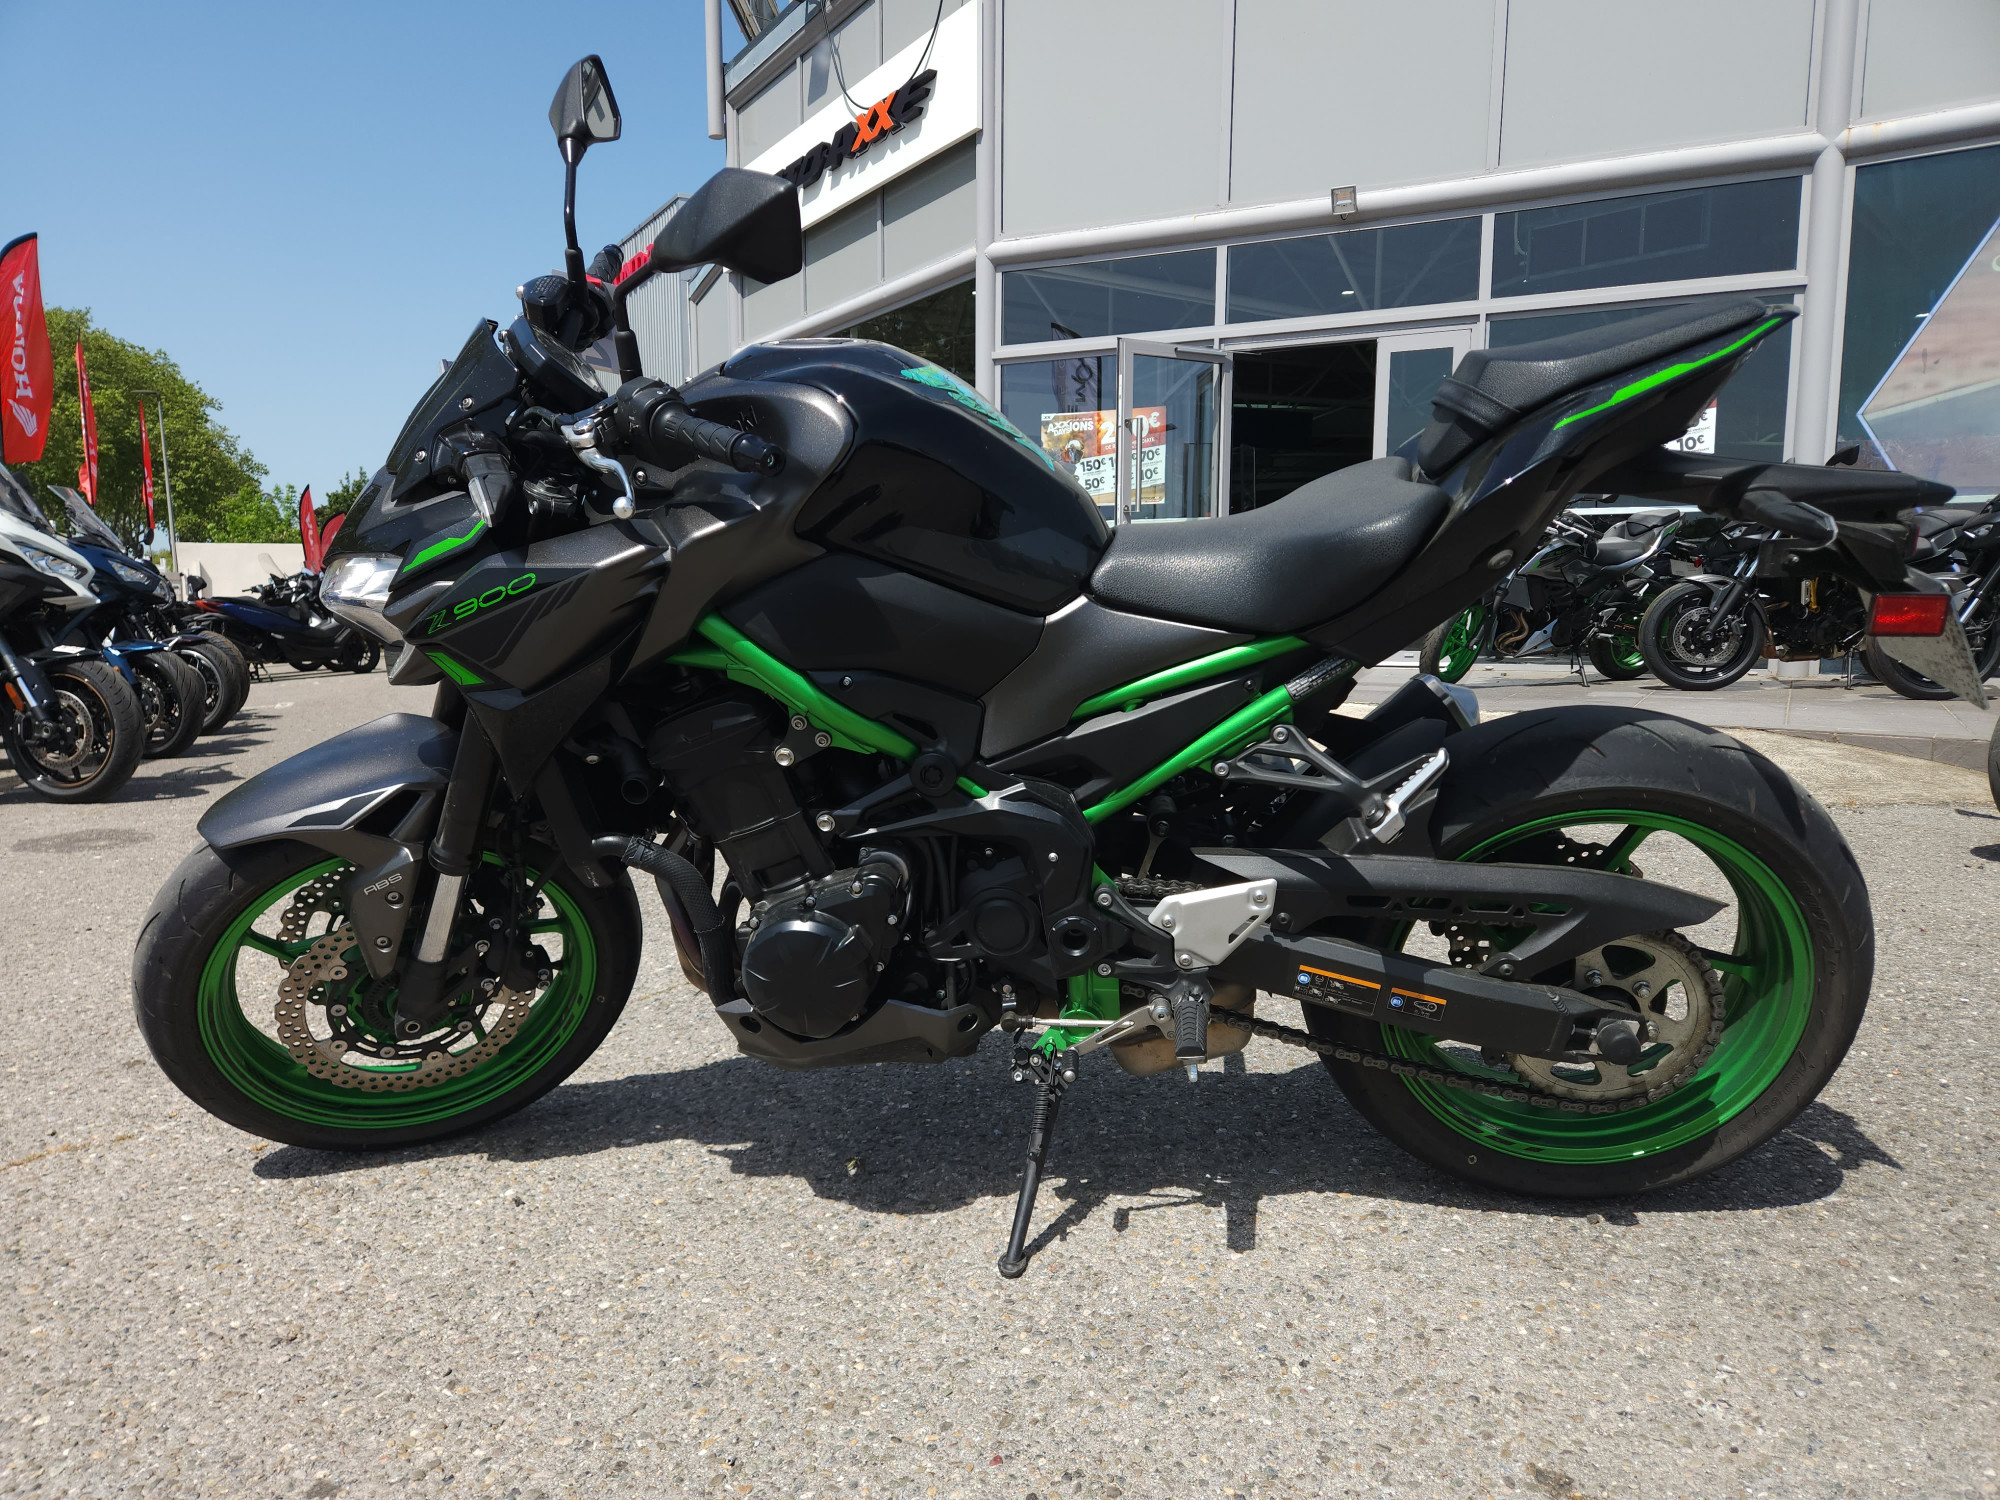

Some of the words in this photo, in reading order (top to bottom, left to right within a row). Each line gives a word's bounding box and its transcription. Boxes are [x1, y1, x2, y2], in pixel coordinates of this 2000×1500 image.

[1676, 434, 1705, 451] 10€
[1080, 457, 1107, 472] 150€
[1085, 476, 1106, 490] 50€
[363, 873, 403, 896] ABS
